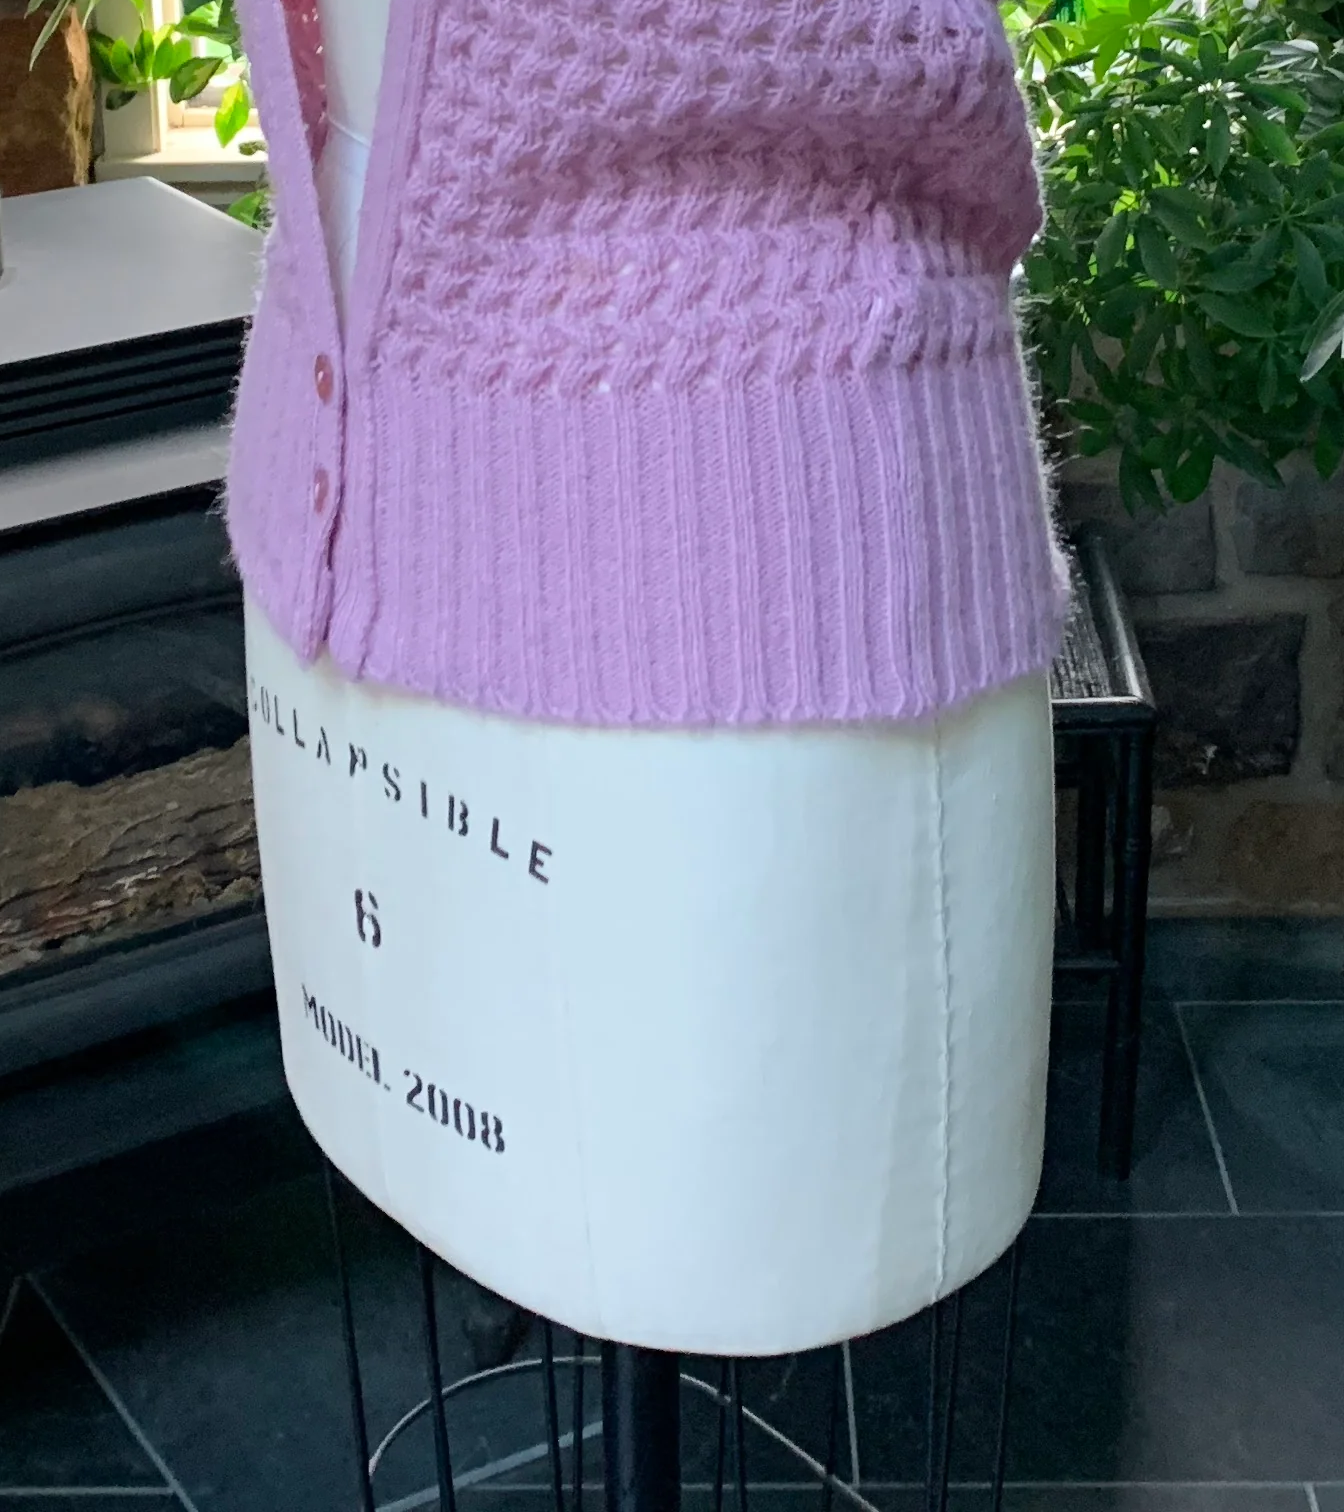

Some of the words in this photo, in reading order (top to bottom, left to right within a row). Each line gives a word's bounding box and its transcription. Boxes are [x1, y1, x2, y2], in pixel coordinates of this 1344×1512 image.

[354, 888, 382, 949] 6
[301, 982, 391, 1092] MODEL
[403, 1068, 506, 1154] 2008
